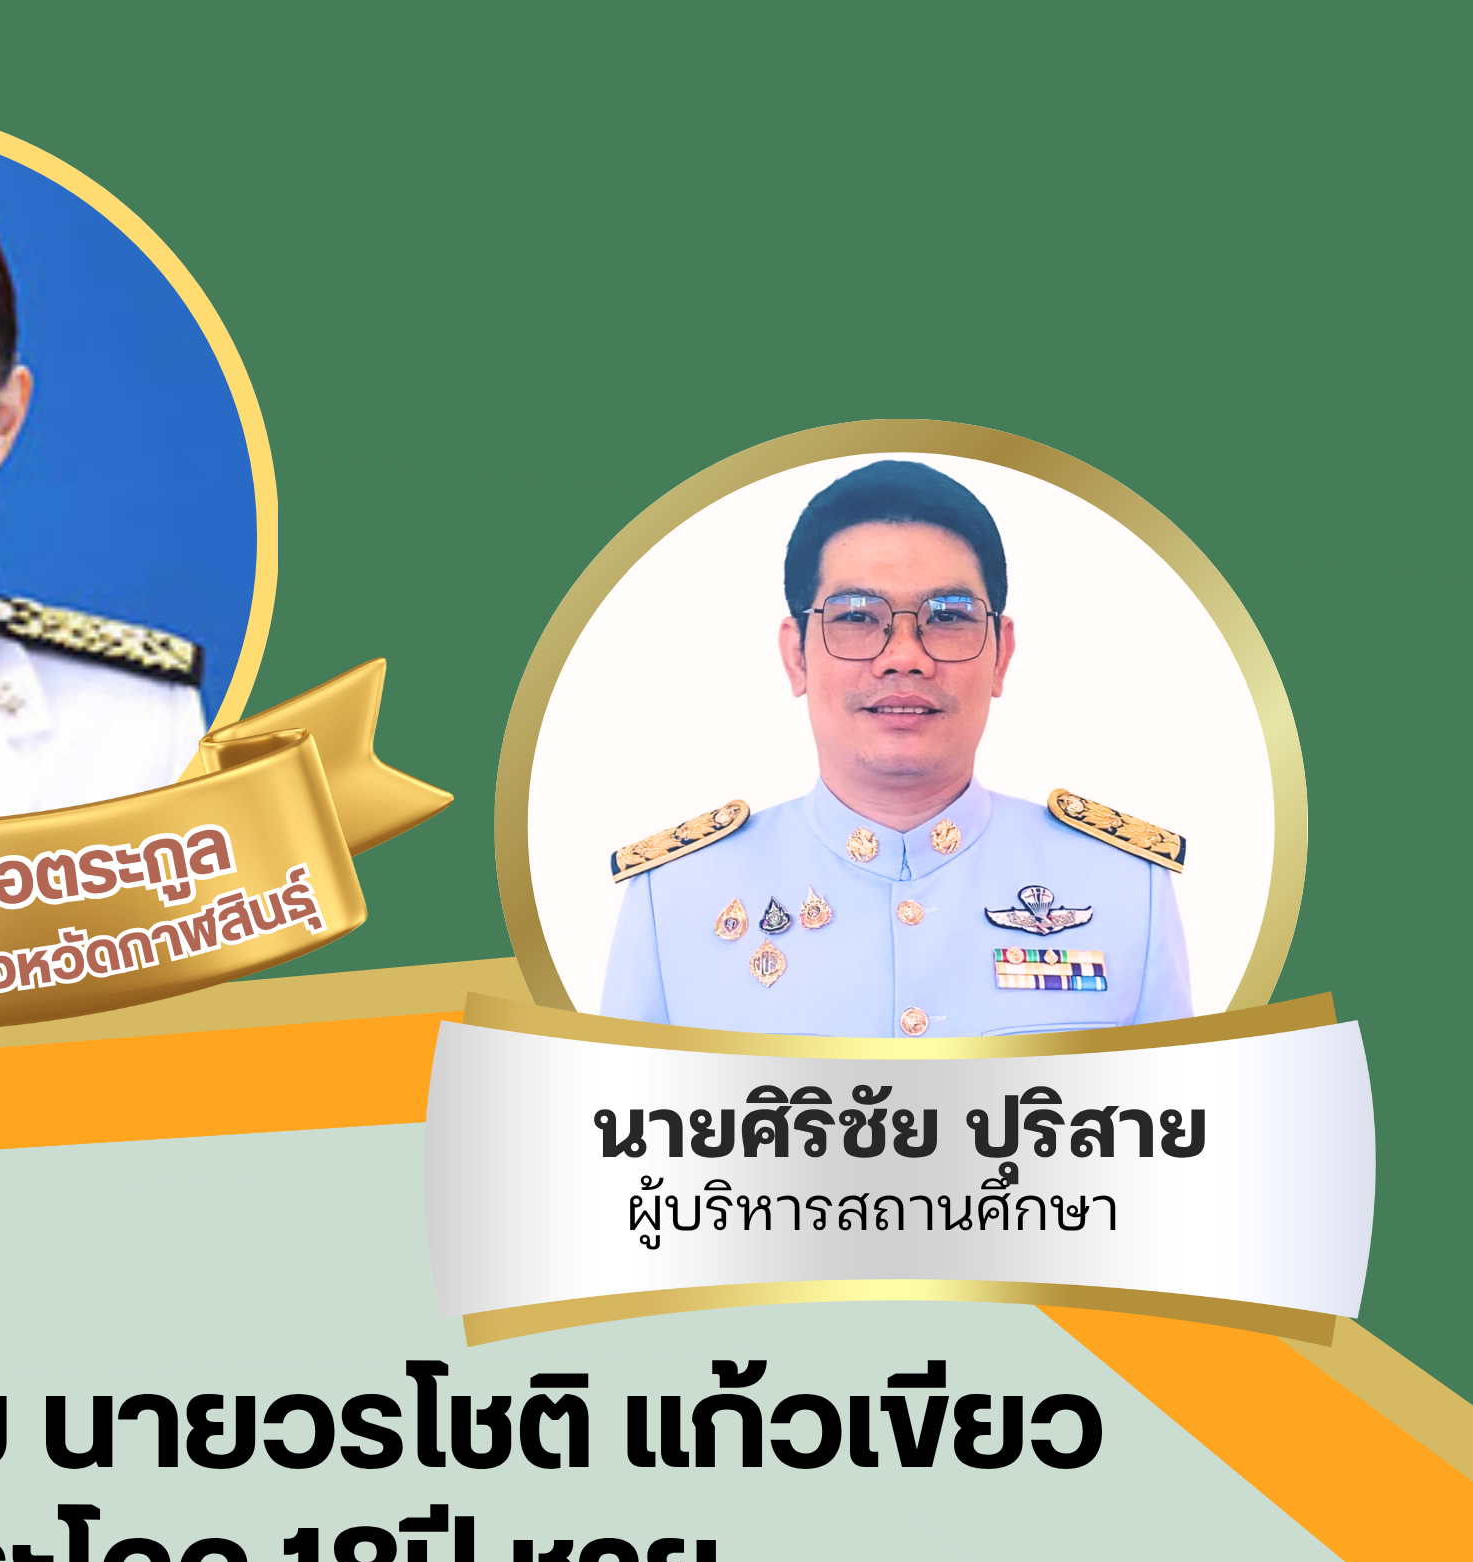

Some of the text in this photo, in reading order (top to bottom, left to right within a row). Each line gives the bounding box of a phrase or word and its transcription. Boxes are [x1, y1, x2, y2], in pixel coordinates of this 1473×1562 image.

[592, 1083, 1207, 1186] นายศิริชัย ปุริสาย
[627, 1173, 1118, 1252] ผู้บริหารสถานศึกษา
[44, 1358, 591, 1471] นายวรโชติ
[625, 1358, 1104, 1471] แก้วเขียว
